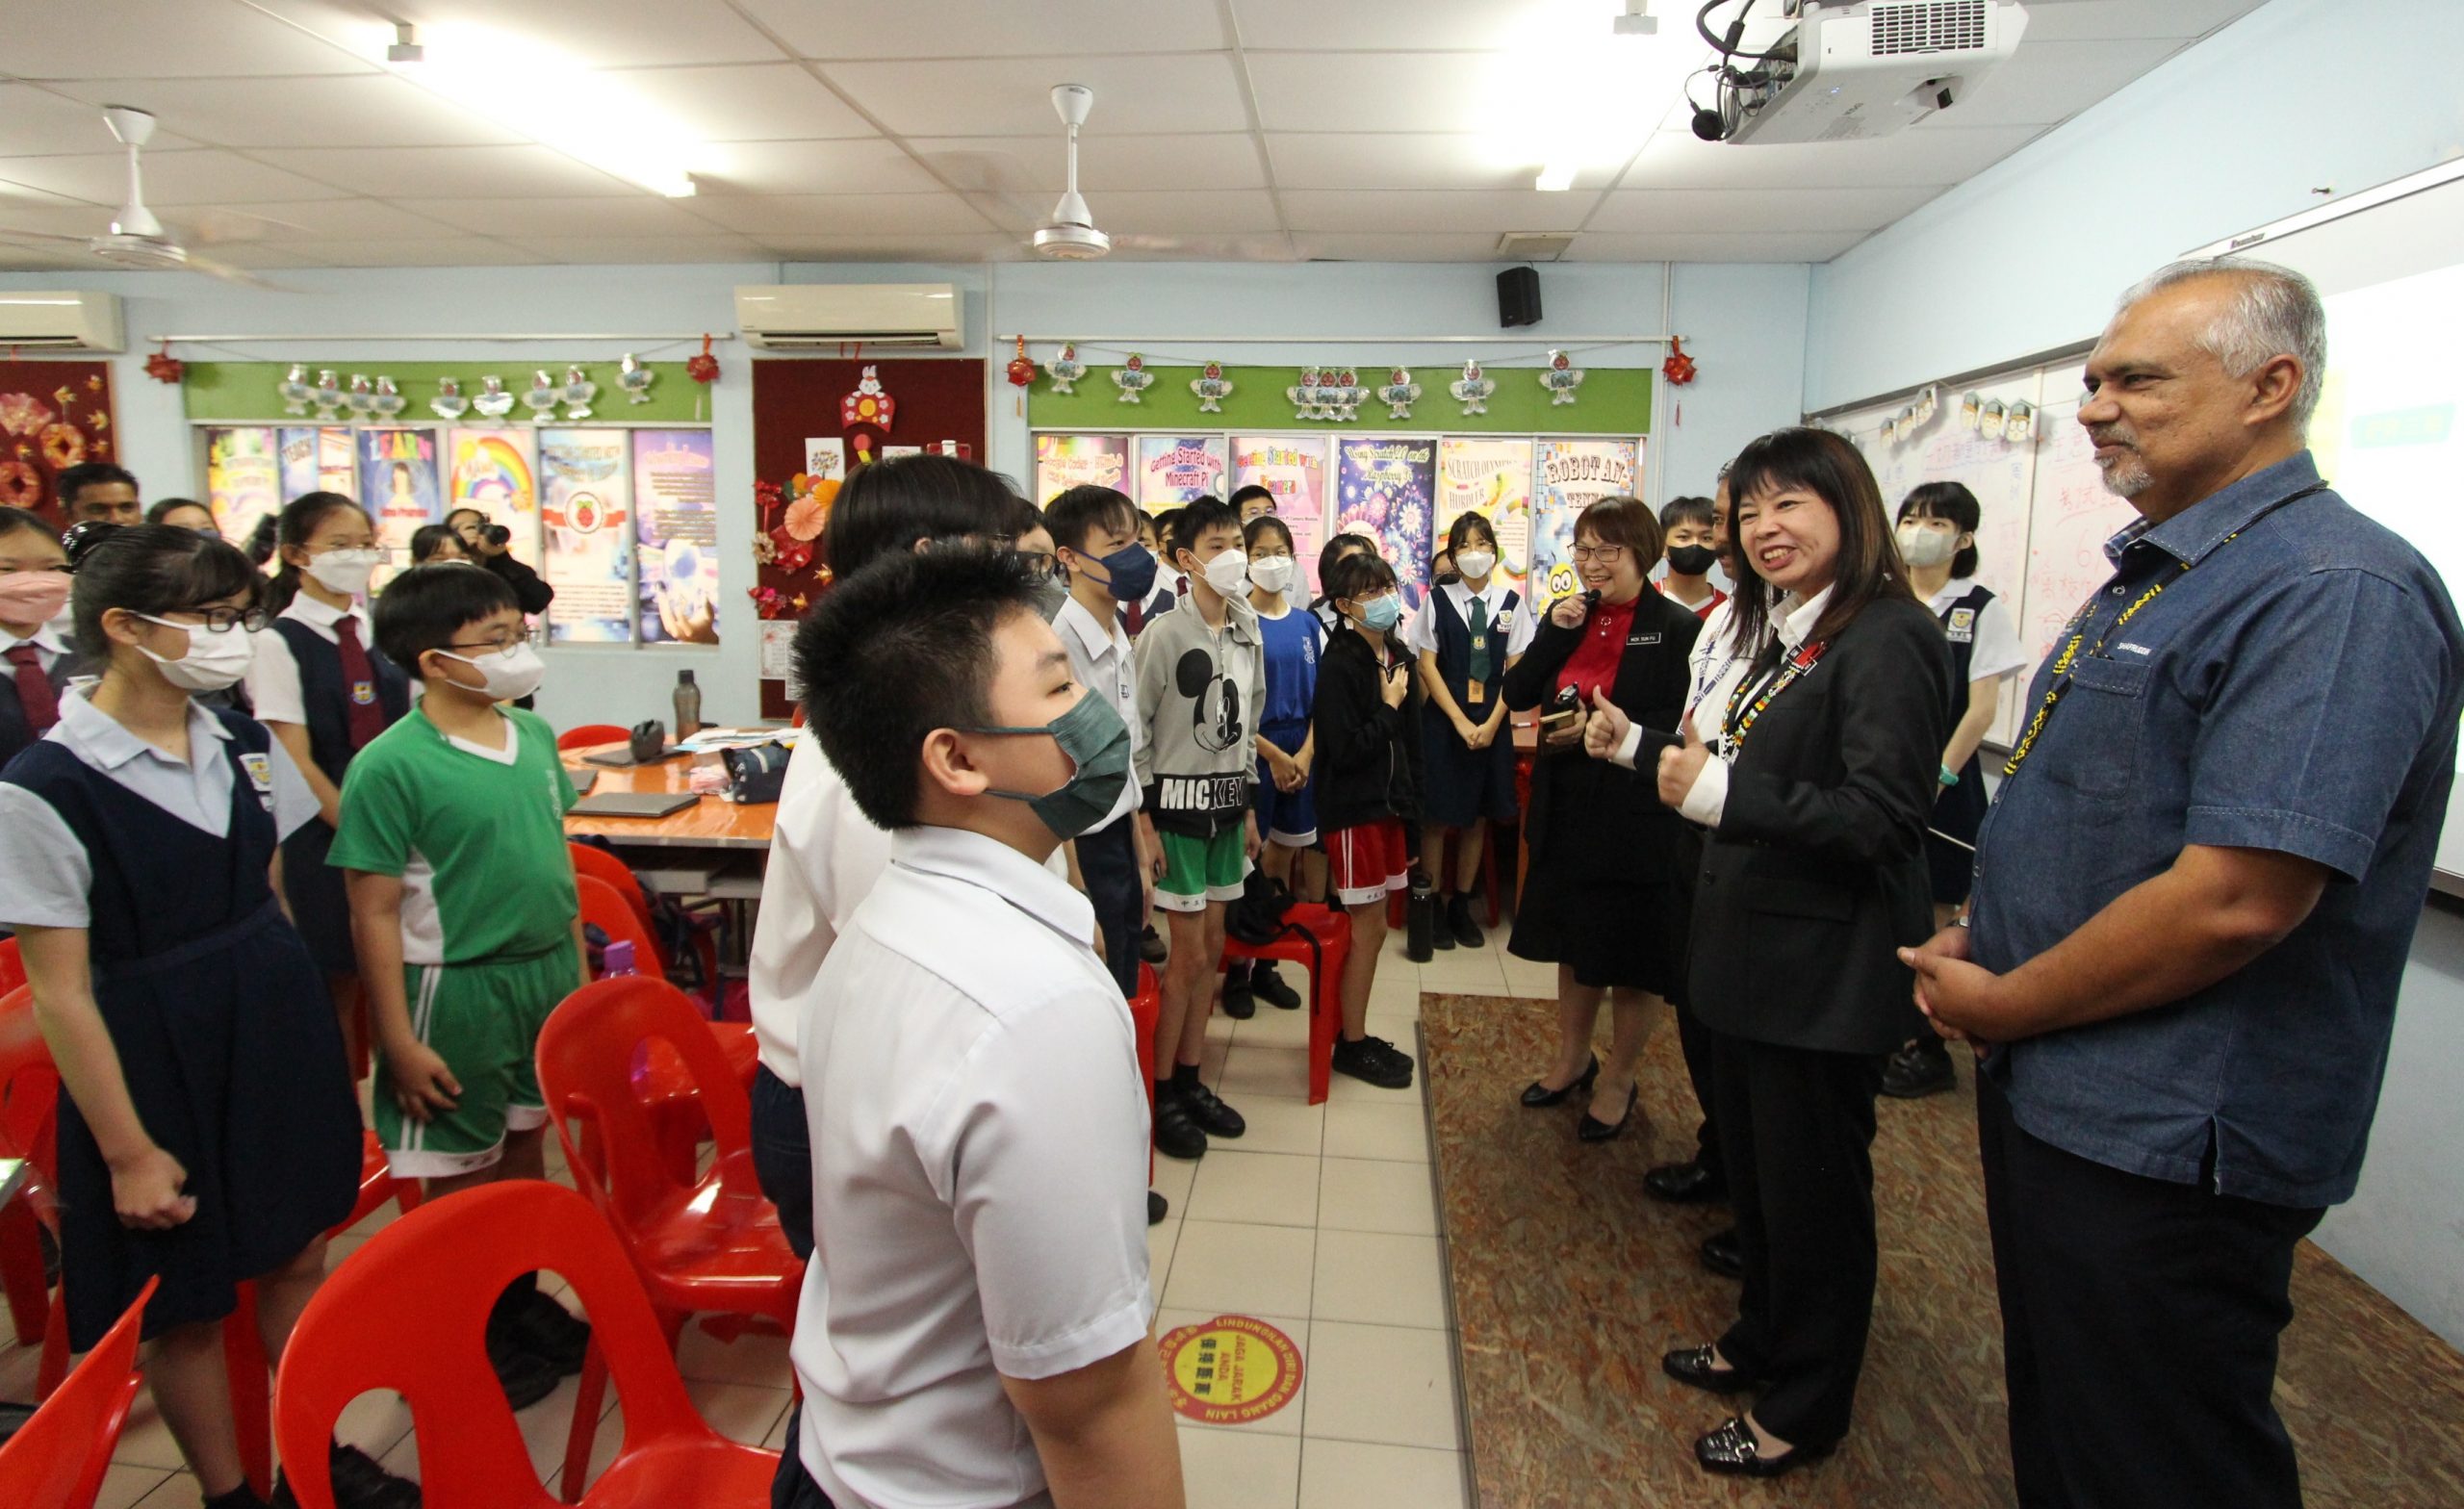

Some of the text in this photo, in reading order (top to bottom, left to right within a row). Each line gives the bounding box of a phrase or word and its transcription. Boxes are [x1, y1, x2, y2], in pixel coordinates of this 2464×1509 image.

[1150, 448, 1222, 473] Getting Started with
[1268, 446, 1297, 467] Started
[1165, 471, 1209, 487] Minecraft Pi
[1448, 459, 1480, 479] SCRATCH
[1547, 454, 1601, 484] ROBOT
[1160, 776, 1245, 810] MICKEY
[1205, 1408, 1238, 1420] LAIN
